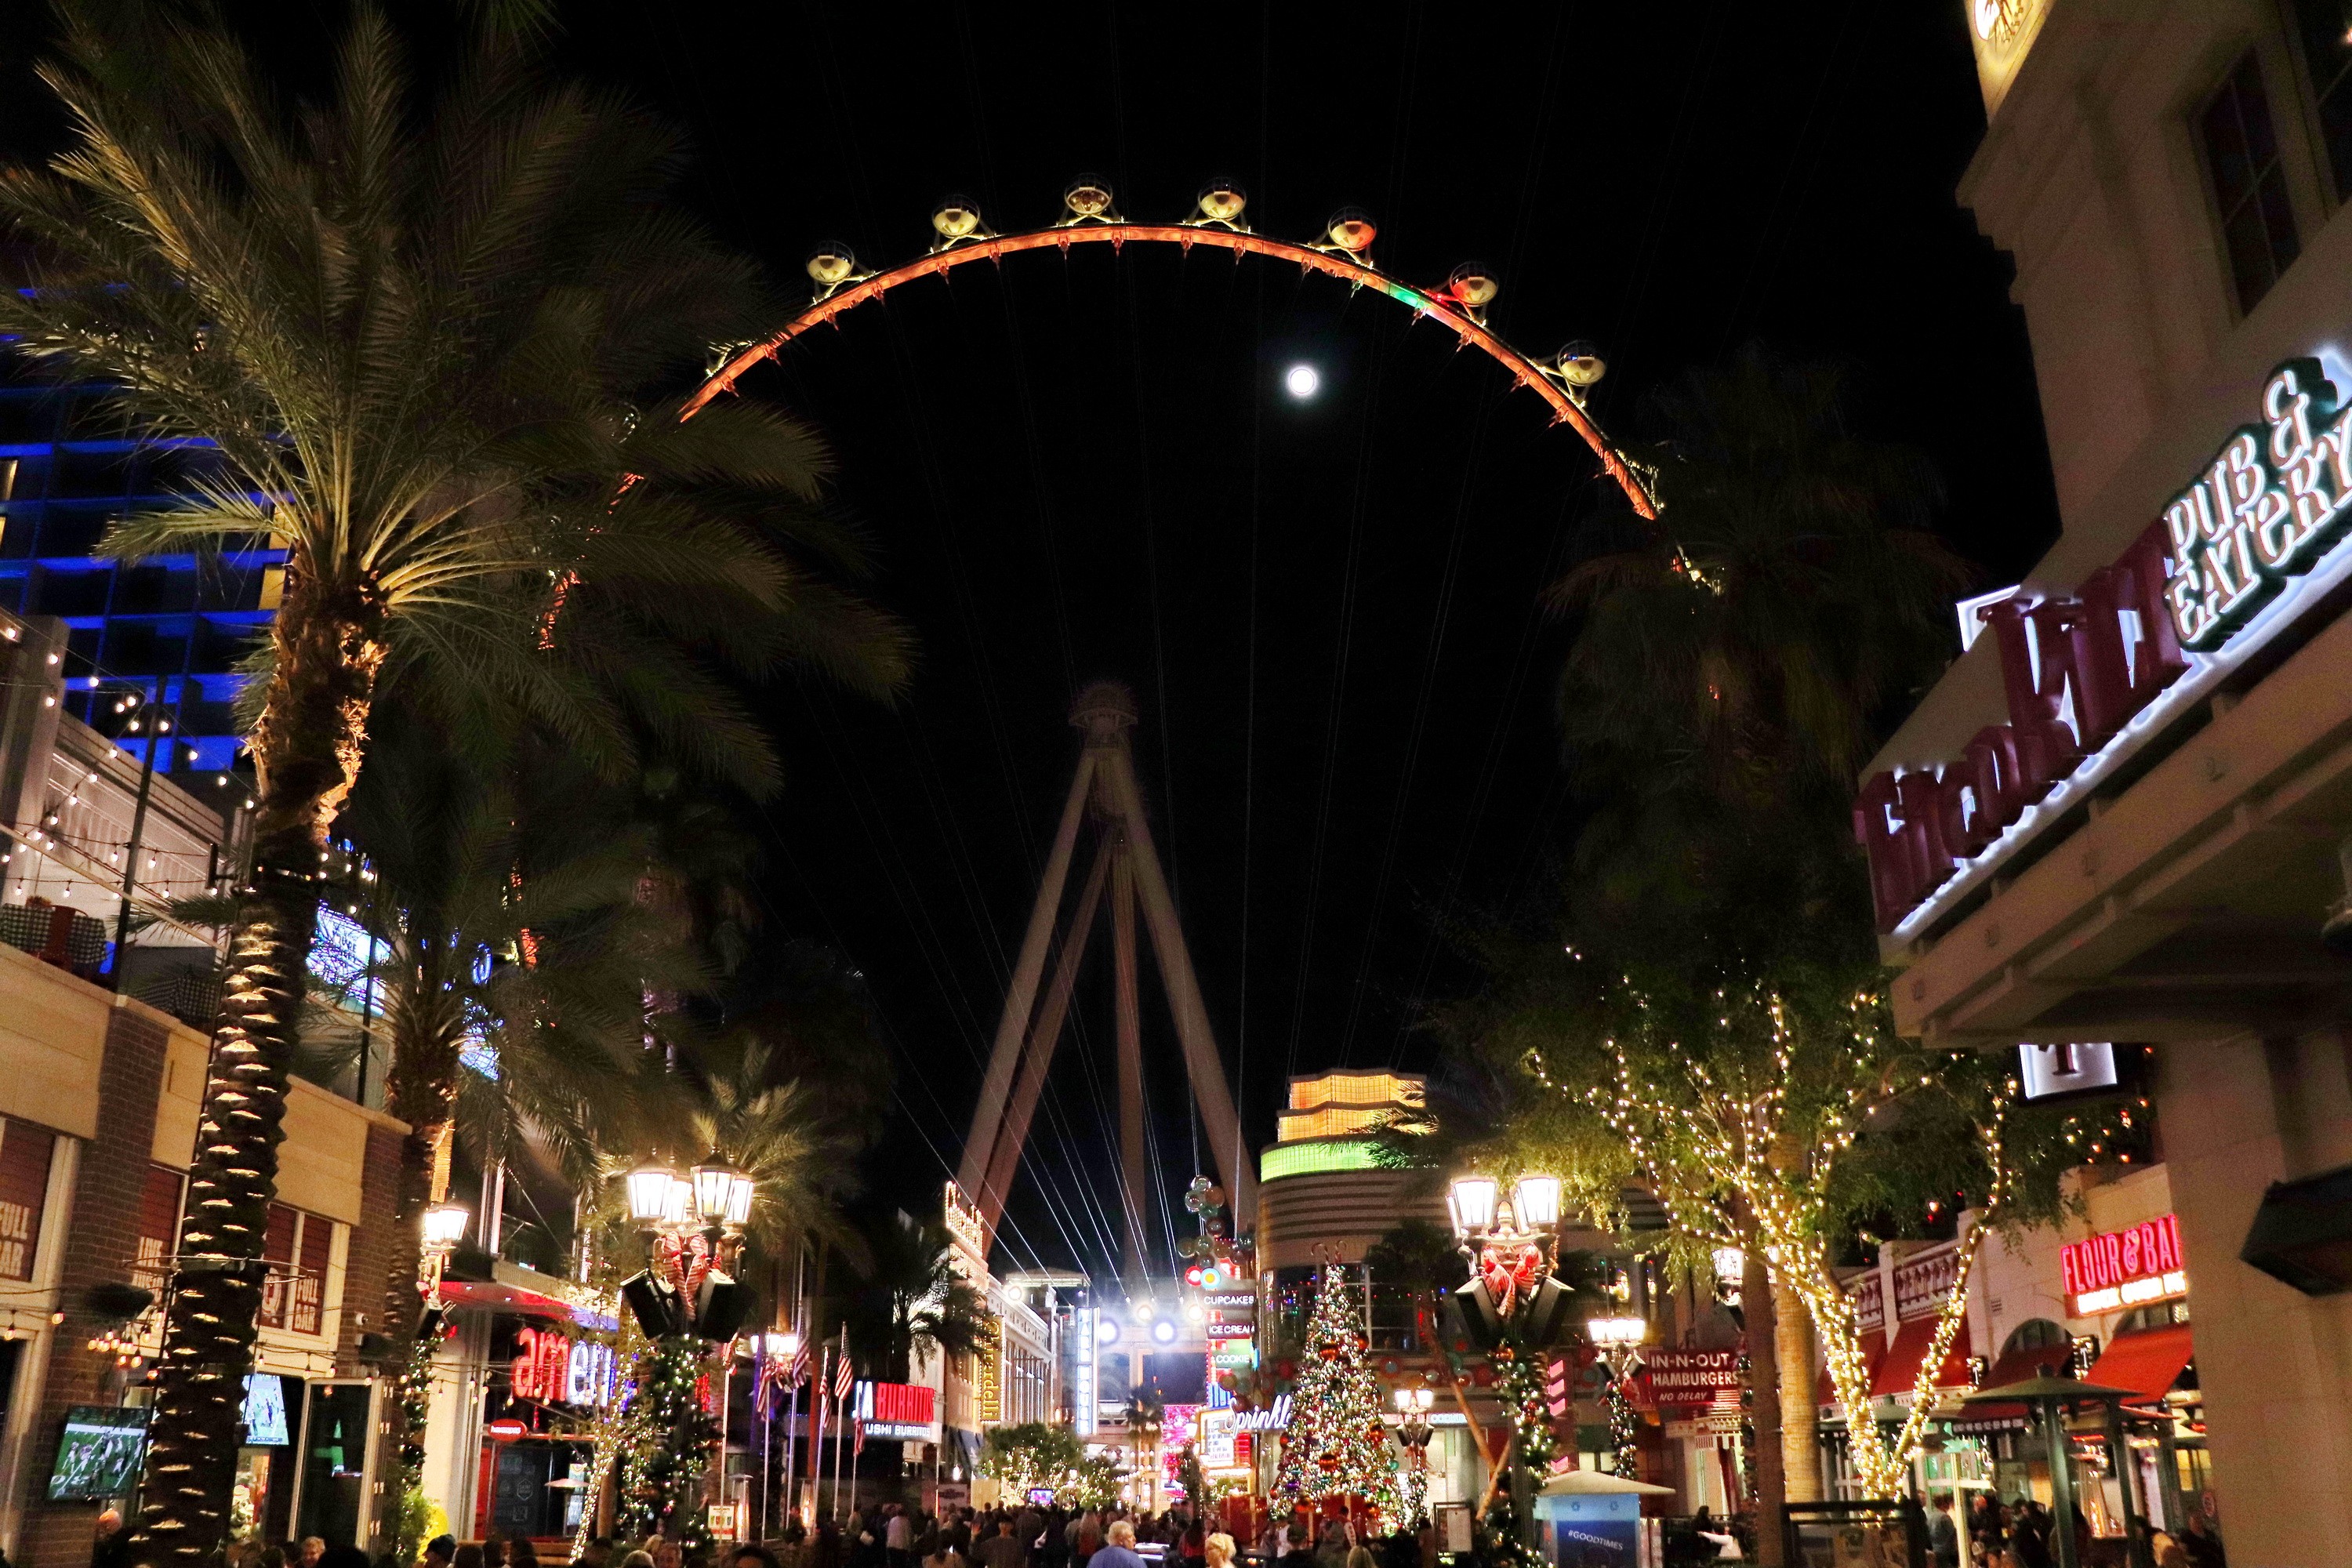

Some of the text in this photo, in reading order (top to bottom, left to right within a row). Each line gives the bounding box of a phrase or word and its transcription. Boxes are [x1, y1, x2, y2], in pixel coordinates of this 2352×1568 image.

[2162, 433, 2267, 577] PUB
[136, 1236, 164, 1268] LIVE
[2061, 1232, 2123, 1295] FLOUR
[2122, 1228, 2140, 1275] &
[297, 1276, 319, 1304] FULL
[1203, 1295, 1254, 1305] CUPCAKES
[293, 1303, 316, 1332] BAR
[1209, 1325, 1223, 1334] ICE
[1651, 1352, 1730, 1369] IN-N-OUT
[1651, 1370, 1739, 1387] HAMBURGERS
[1659, 1391, 1708, 1402] NO DELAY
[862, 1423, 931, 1437] USHI BURRITOS
[1568, 1529, 1624, 1552] #GOODTIMES
